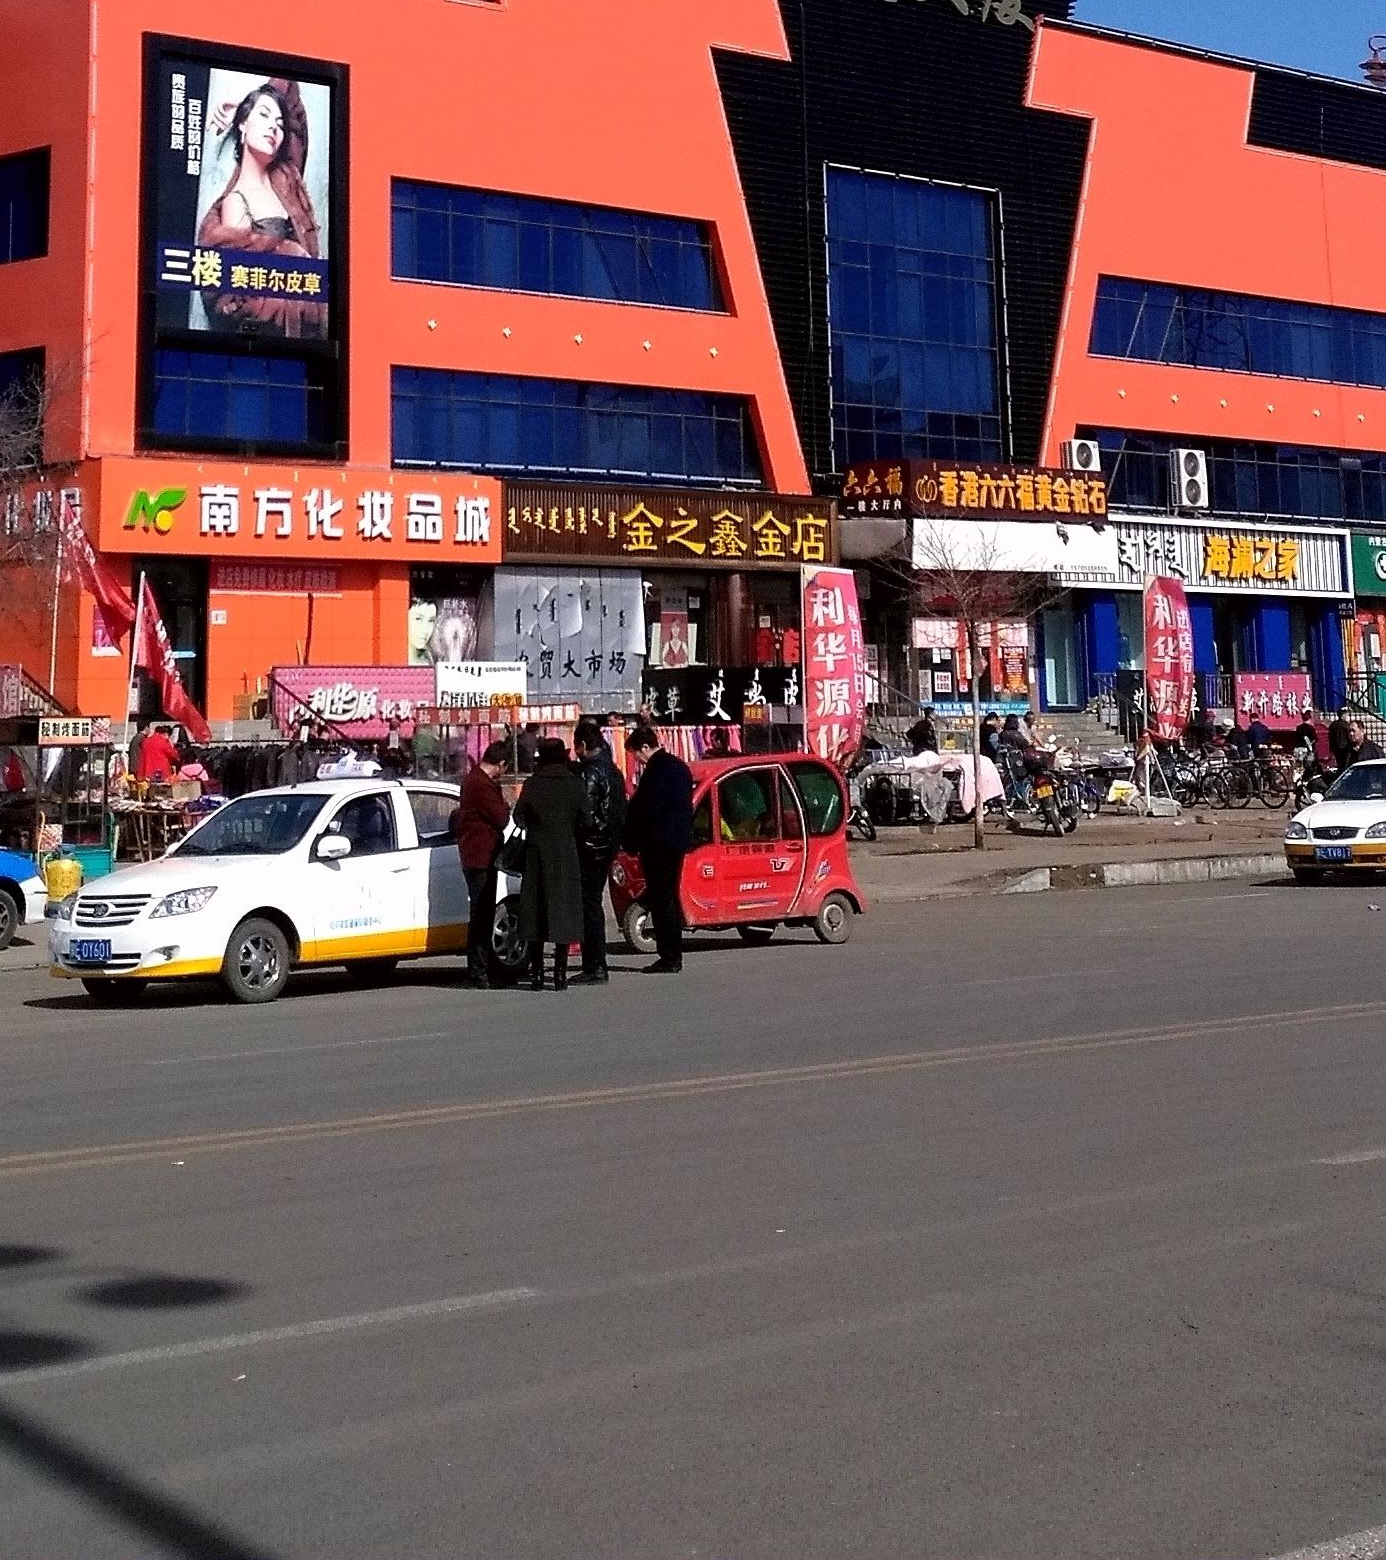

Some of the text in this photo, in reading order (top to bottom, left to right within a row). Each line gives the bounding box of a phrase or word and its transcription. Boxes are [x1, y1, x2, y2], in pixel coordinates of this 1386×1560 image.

[162, 248, 322, 295] 三楼 赛菲尔皮草
[198, 482, 492, 543] 南方化妆品城
[938, 469, 1108, 516] 香港六六福黄金钻石
[621, 502, 830, 561] 金之鑫金店
[1201, 534, 1301, 582] 海澜之家
